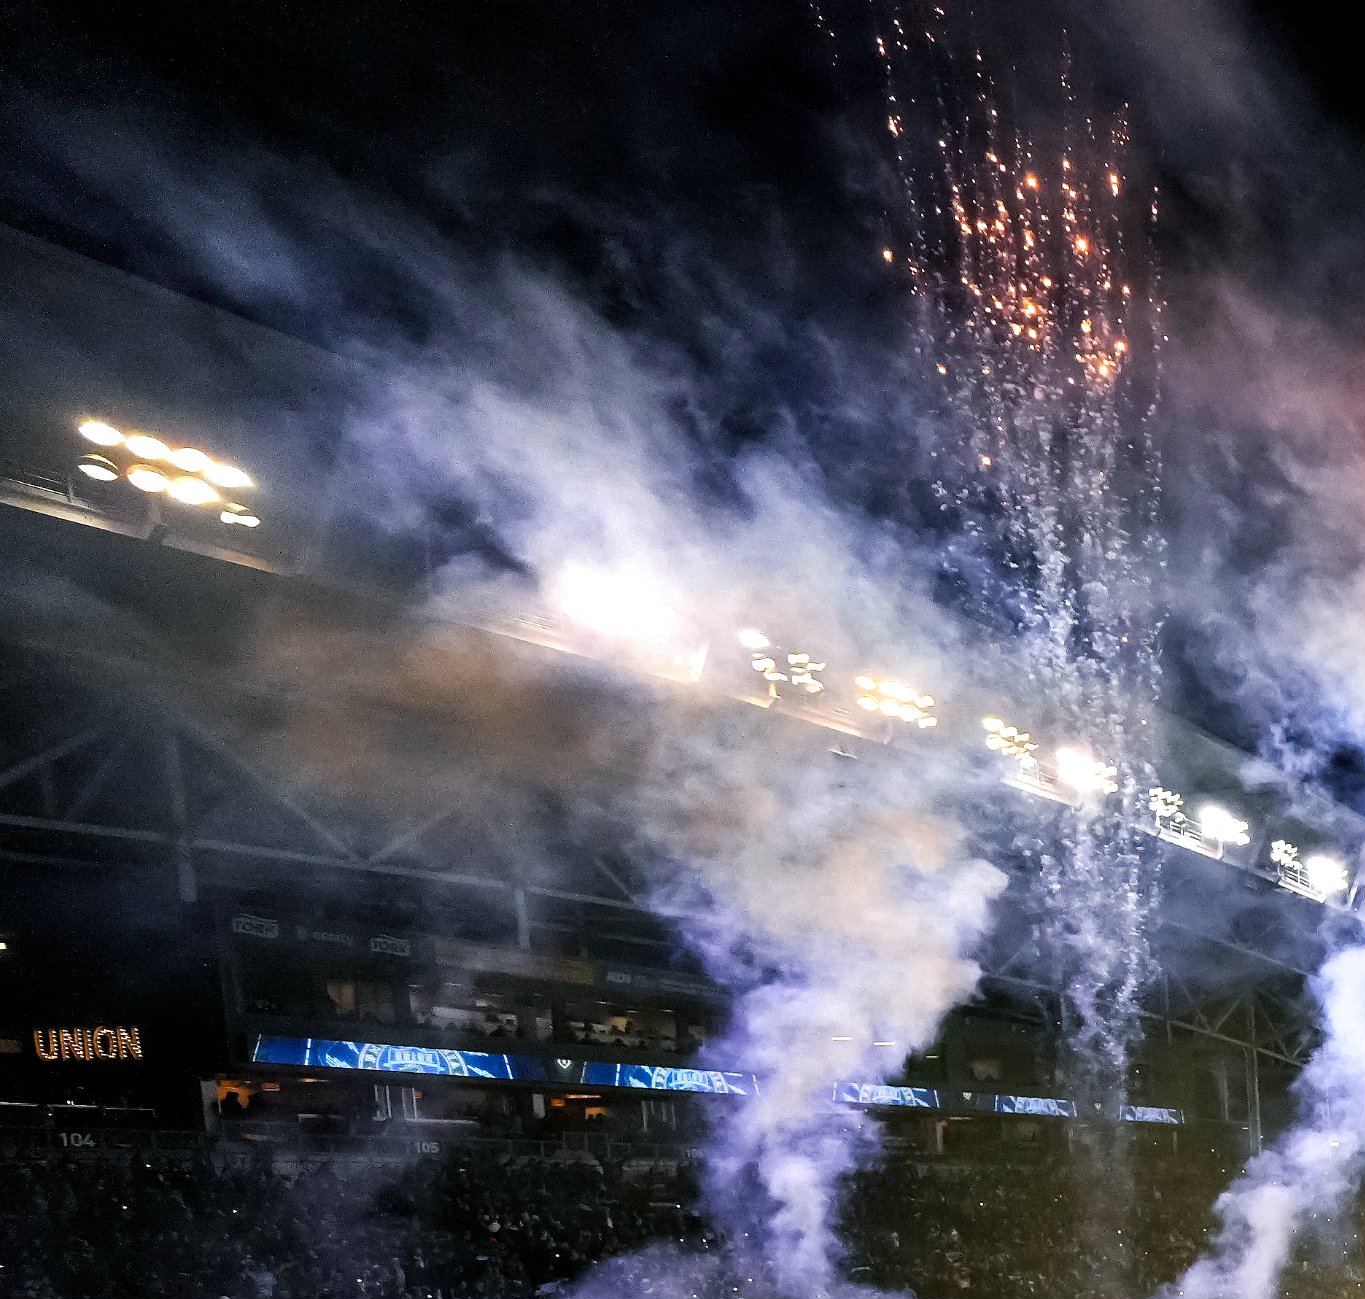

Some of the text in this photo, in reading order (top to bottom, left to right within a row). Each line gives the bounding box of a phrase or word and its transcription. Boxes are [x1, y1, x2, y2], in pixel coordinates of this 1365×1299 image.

[33, 1026, 144, 1062] UNION
[60, 1132, 95, 1147] 104
[415, 1141, 439, 1154] 105
